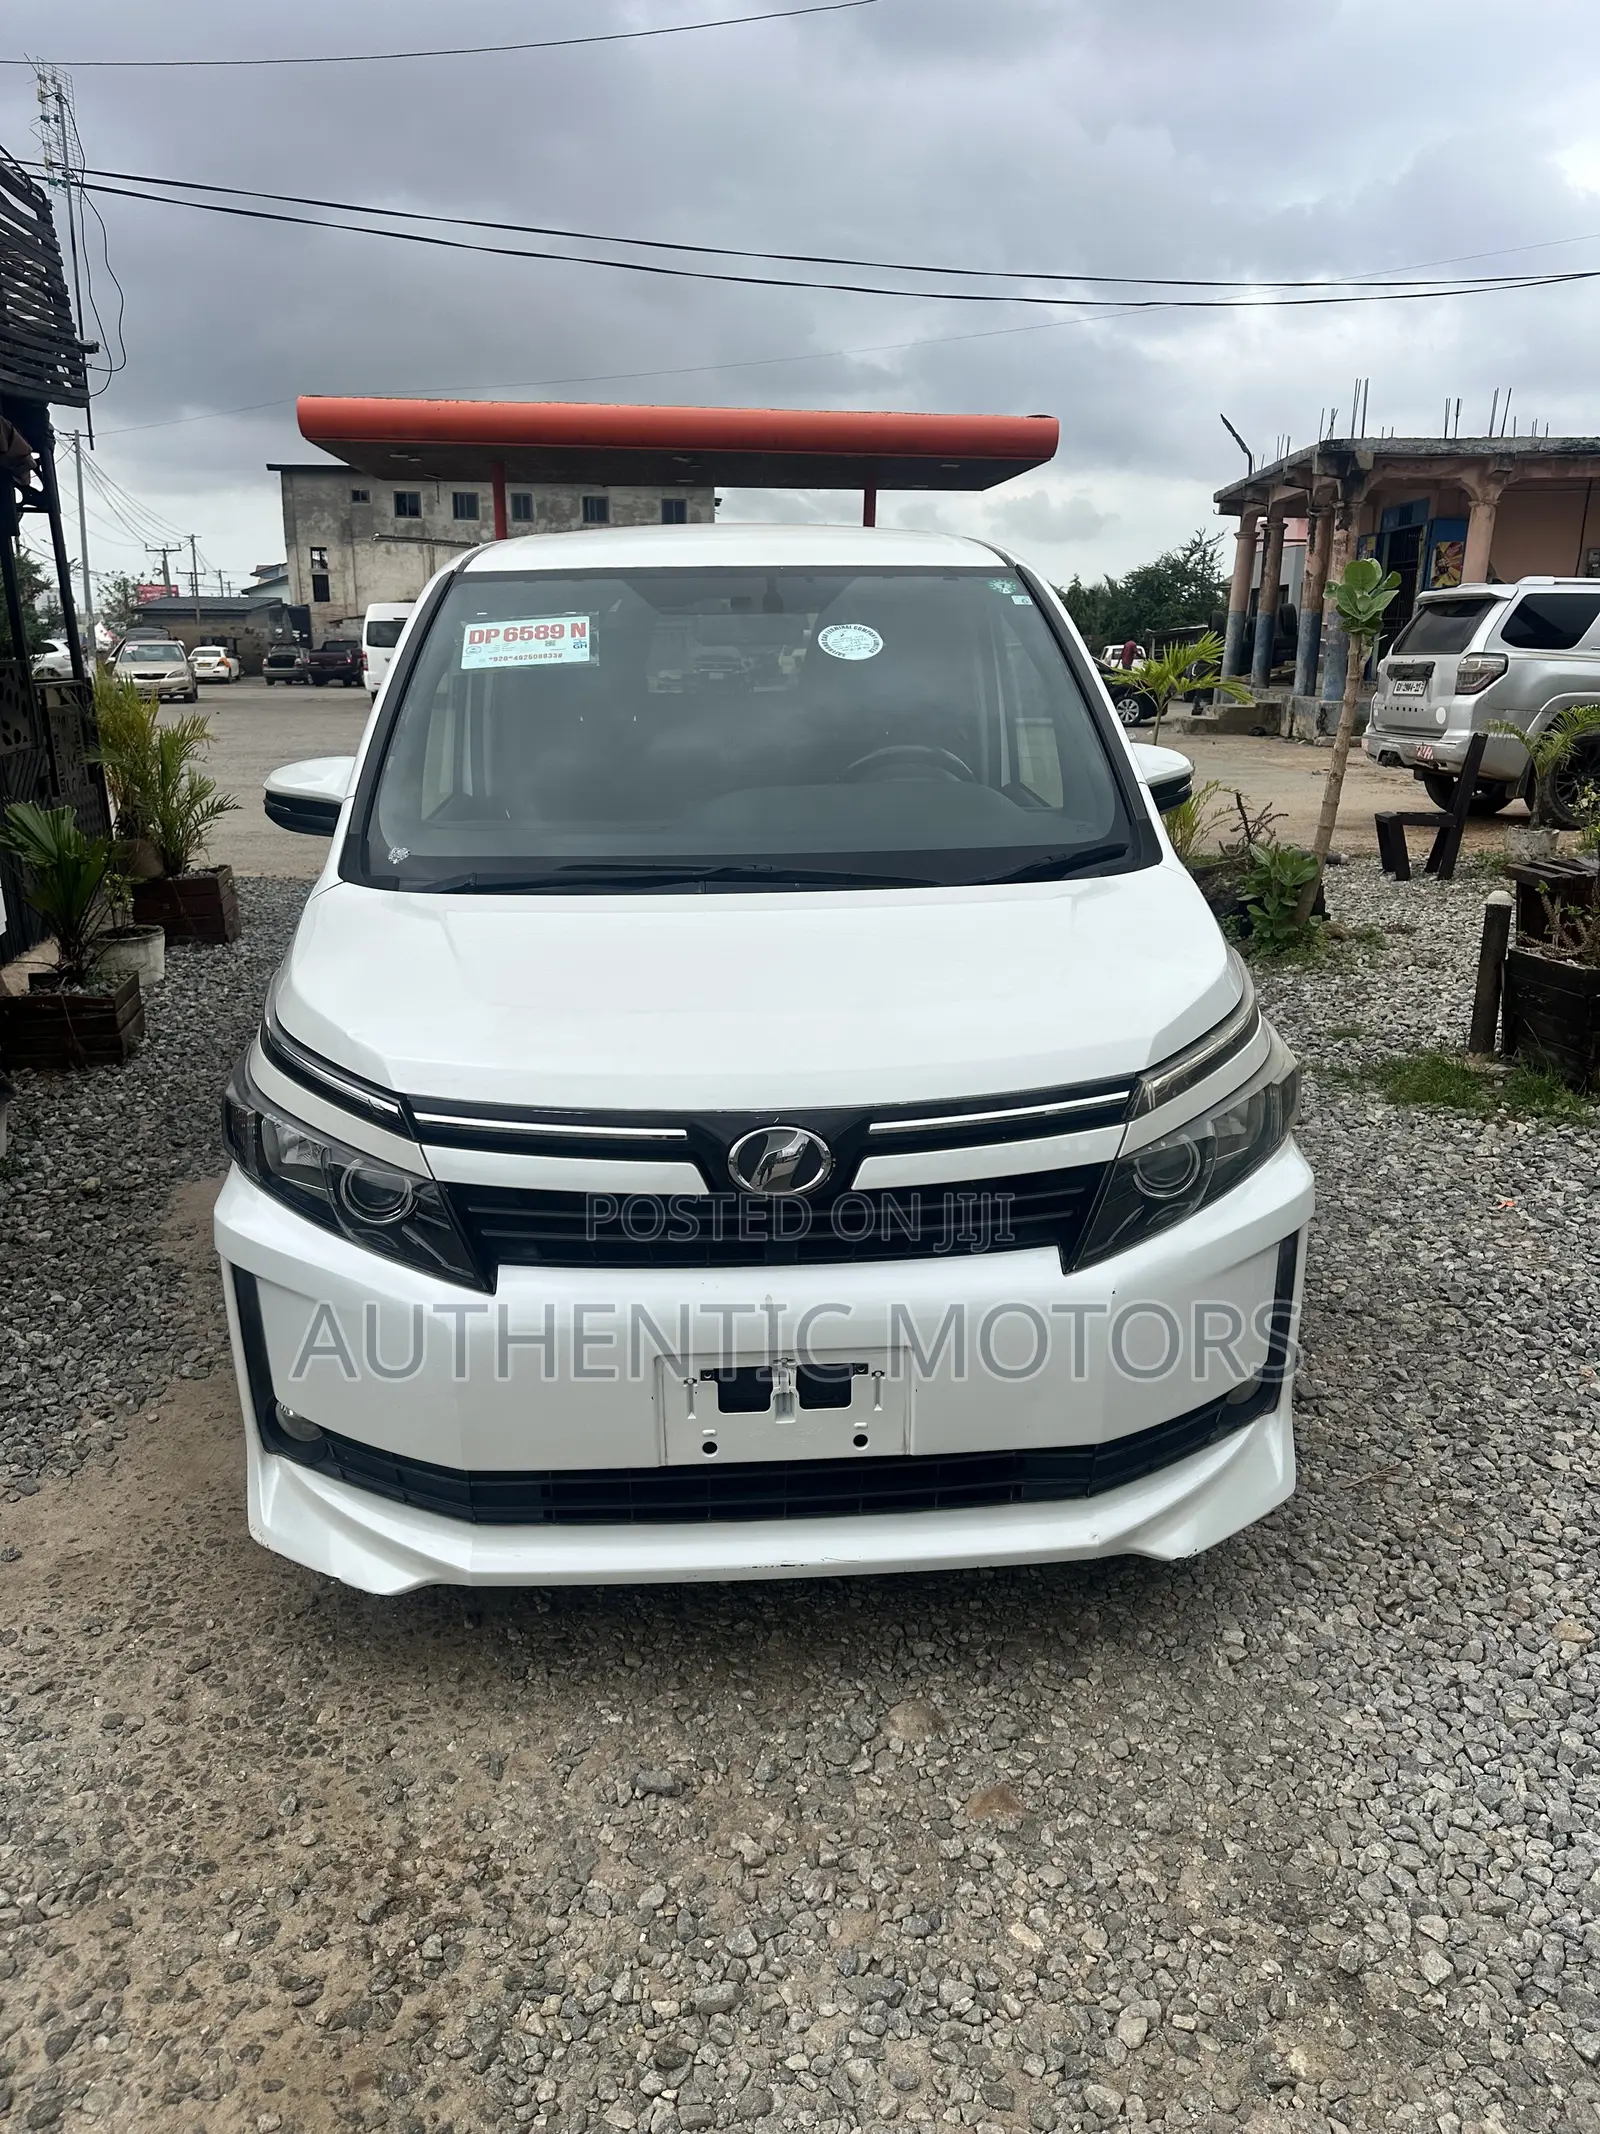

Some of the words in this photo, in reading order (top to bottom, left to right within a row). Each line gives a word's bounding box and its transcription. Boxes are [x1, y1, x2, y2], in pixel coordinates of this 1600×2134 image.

[468, 628, 500, 645] DP
[503, 624, 565, 643] 6589
[570, 622, 586, 639] N
